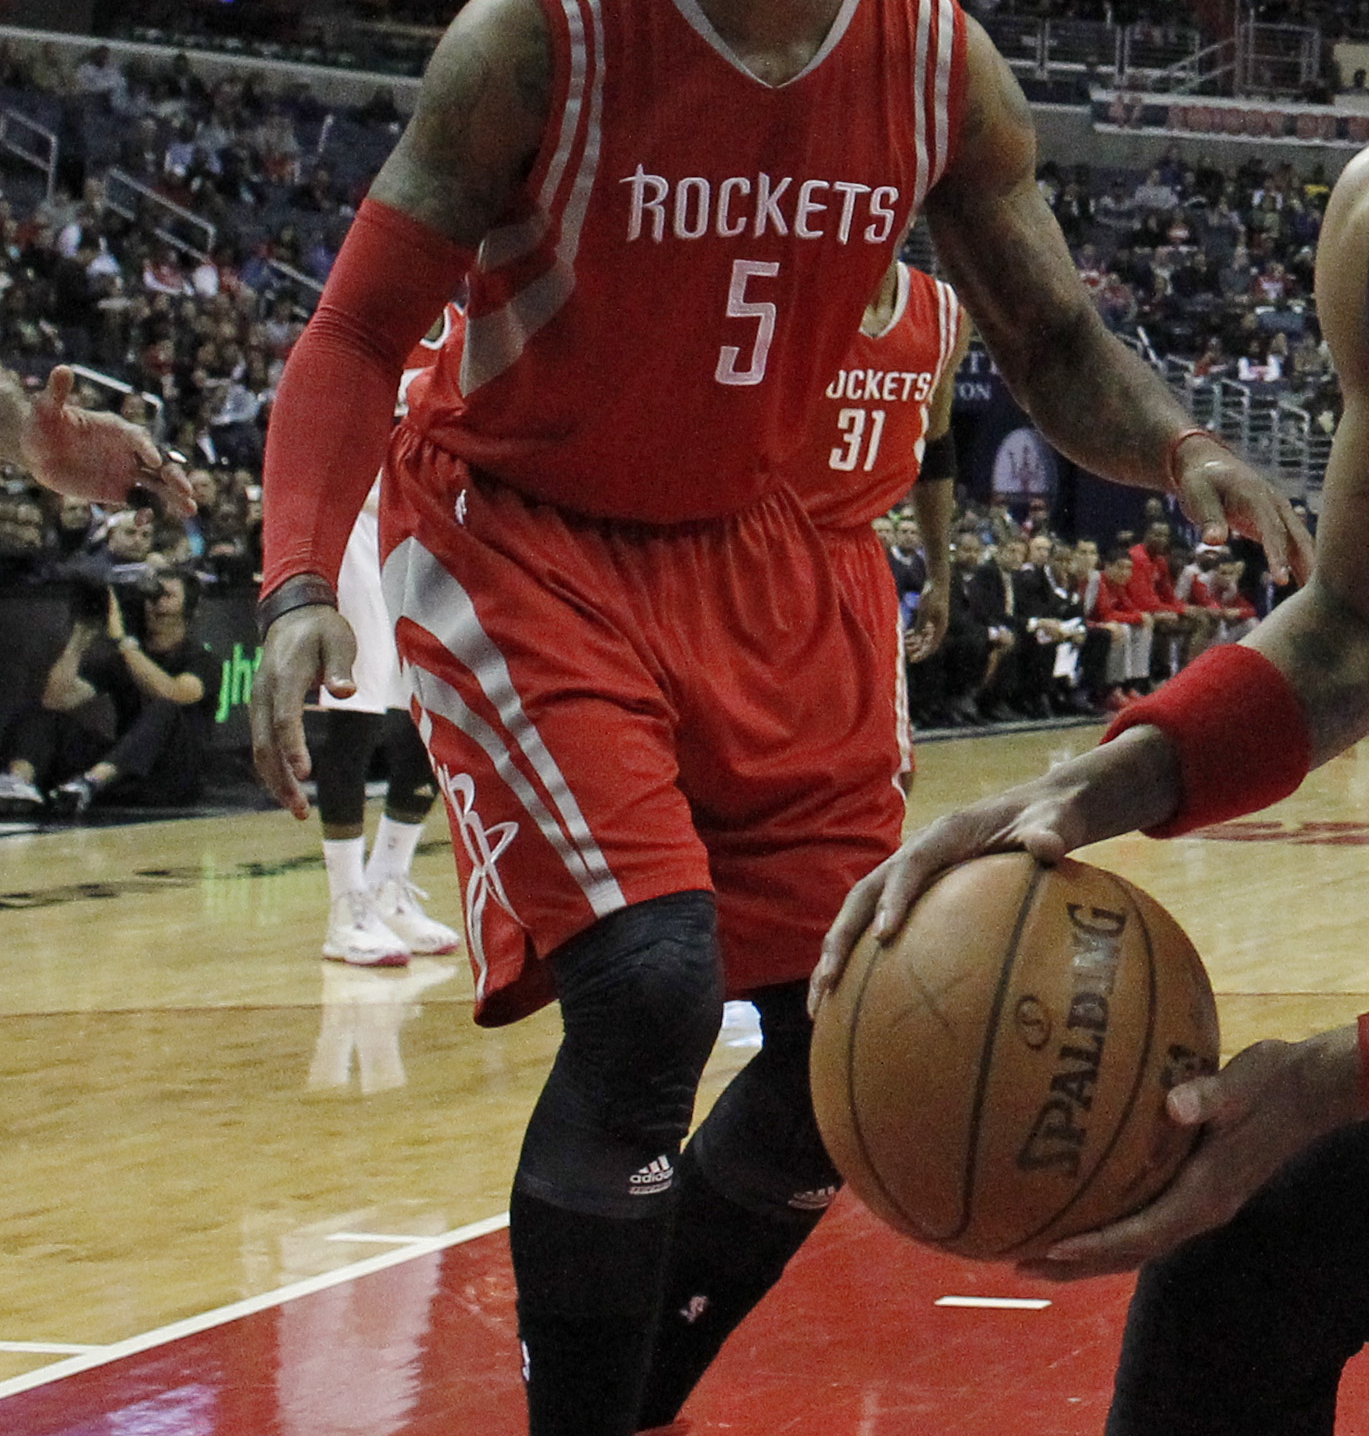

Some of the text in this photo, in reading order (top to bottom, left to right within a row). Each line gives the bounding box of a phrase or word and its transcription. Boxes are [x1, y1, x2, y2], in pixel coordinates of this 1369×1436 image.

[619, 164, 899, 245] ROCKETS
[714, 259, 780, 386] 5
[826, 369, 933, 402] OCKETS
[828, 408, 887, 472] 31
